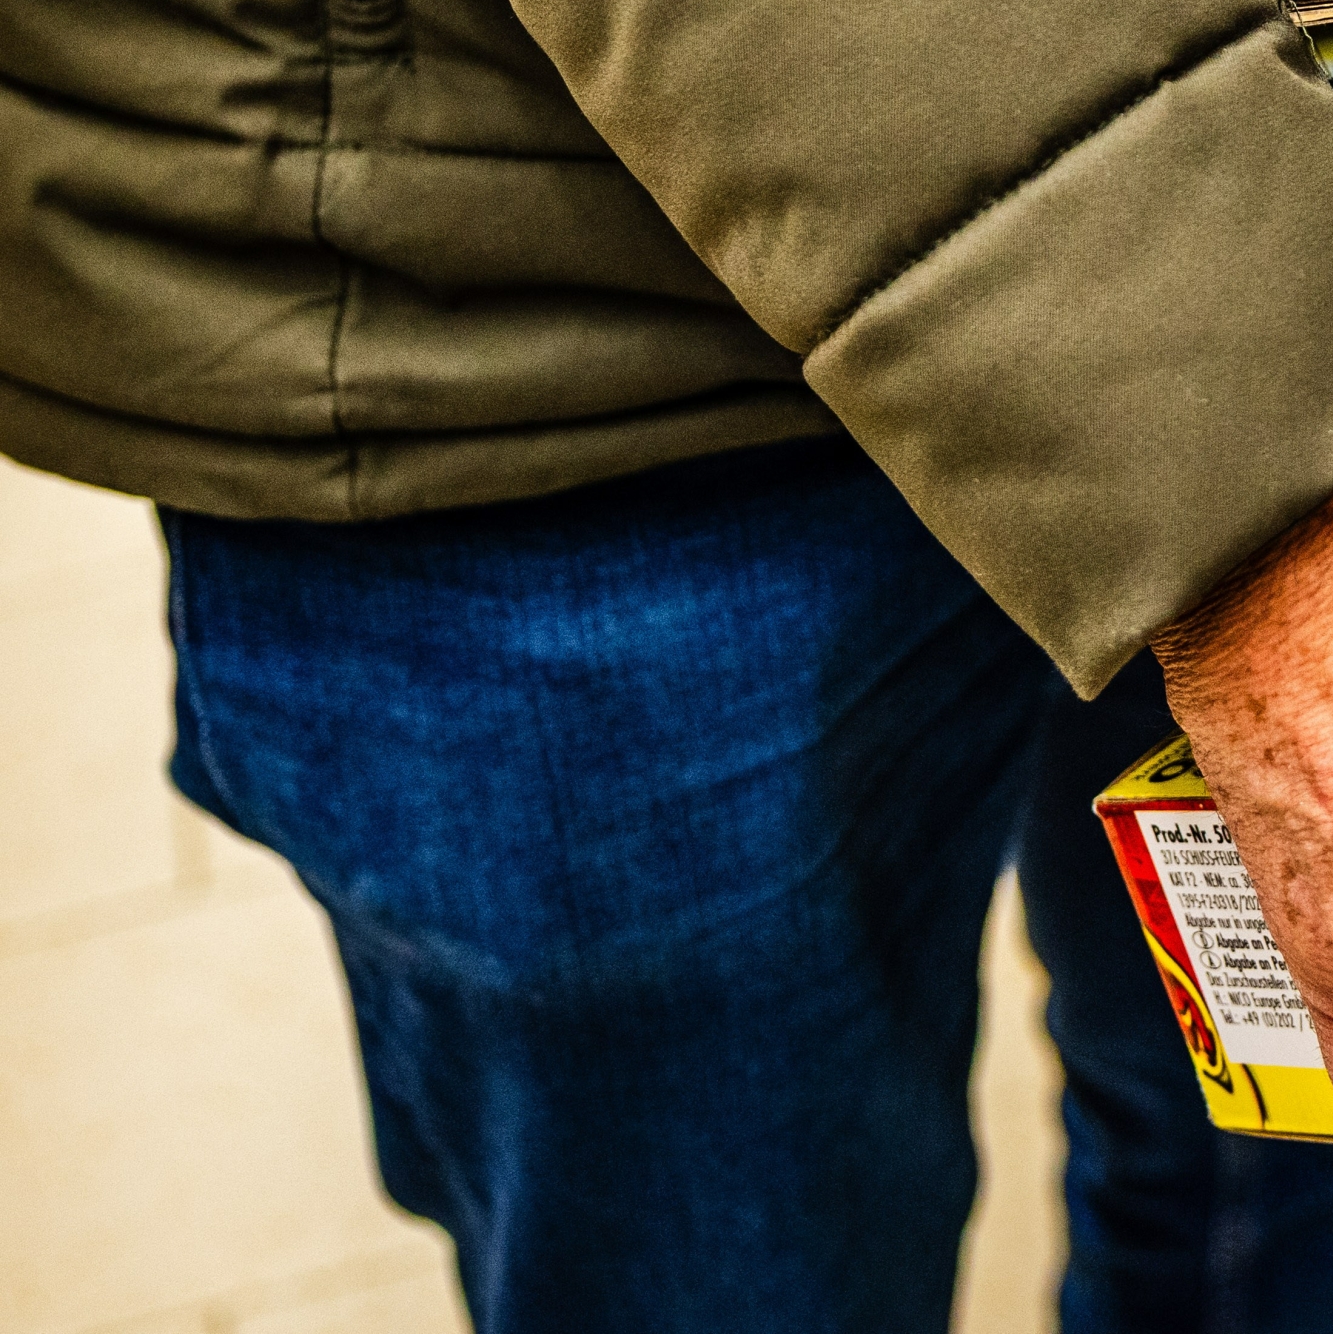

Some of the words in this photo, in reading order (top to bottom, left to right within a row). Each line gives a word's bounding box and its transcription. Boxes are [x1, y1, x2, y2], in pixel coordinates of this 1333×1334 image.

[1151, 823, 1213, 844] Prod.-Nr.
[1212, 823, 1233, 844] 50
[1160, 849, 1181, 865] 376
[1179, 849, 1244, 867] SCHUSS-FEUER
[1169, 871, 1185, 887] KAT
[1184, 871, 1198, 888] F2
[1177, 893, 1262, 917] 1395-F2-0318/202
[1184, 914, 1217, 932] Abgabe
[1215, 916, 1233, 929] nur
[1230, 916, 1243, 929] in
[1215, 933, 1251, 953] Abgabe
[1250, 939, 1265, 950] an
[1223, 953, 1258, 973] Abgabe
[1257, 959, 1272, 970] an
[1223, 972, 1289, 990] Zurschaustellen
[1250, 992, 1282, 1011] Europe
[1281, 993, 1305, 1010] Gmb
